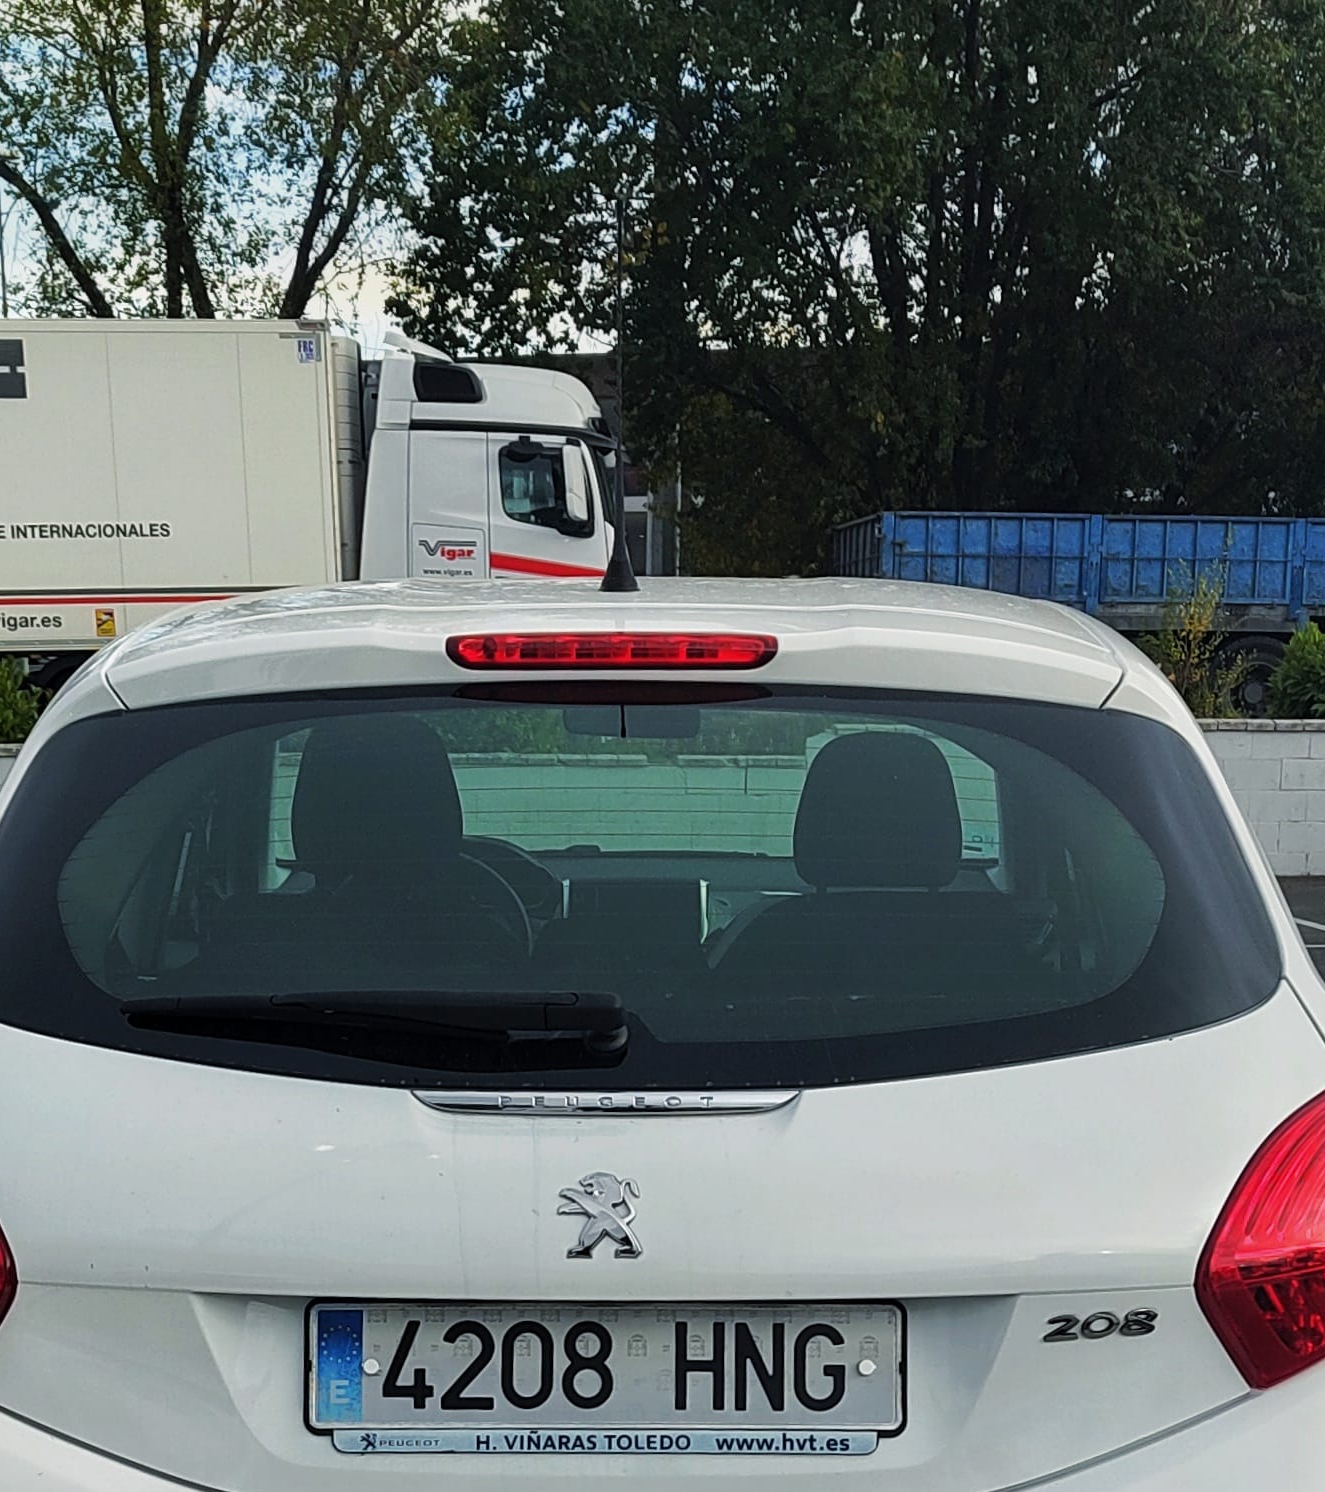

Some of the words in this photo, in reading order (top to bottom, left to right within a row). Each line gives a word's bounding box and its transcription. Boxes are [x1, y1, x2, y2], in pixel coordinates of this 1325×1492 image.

[10, 522, 172, 540] INTERNACIONALES
[418, 539, 478, 561] Vigar
[497, 1094, 715, 1109] PEUGEOT
[1042, 1307, 1159, 1343] 208
[380, 1319, 614, 1411] 4208
[673, 1319, 848, 1412] HNG
[329, 1378, 351, 1405] E
[379, 1439, 441, 1448] PEUGEOT
[475, 1434, 498, 1451] H.
[504, 1430, 598, 1451] VIÑARAS
[604, 1434, 691, 1451] TOLEDO
[715, 1433, 850, 1451] www.hvt.es
